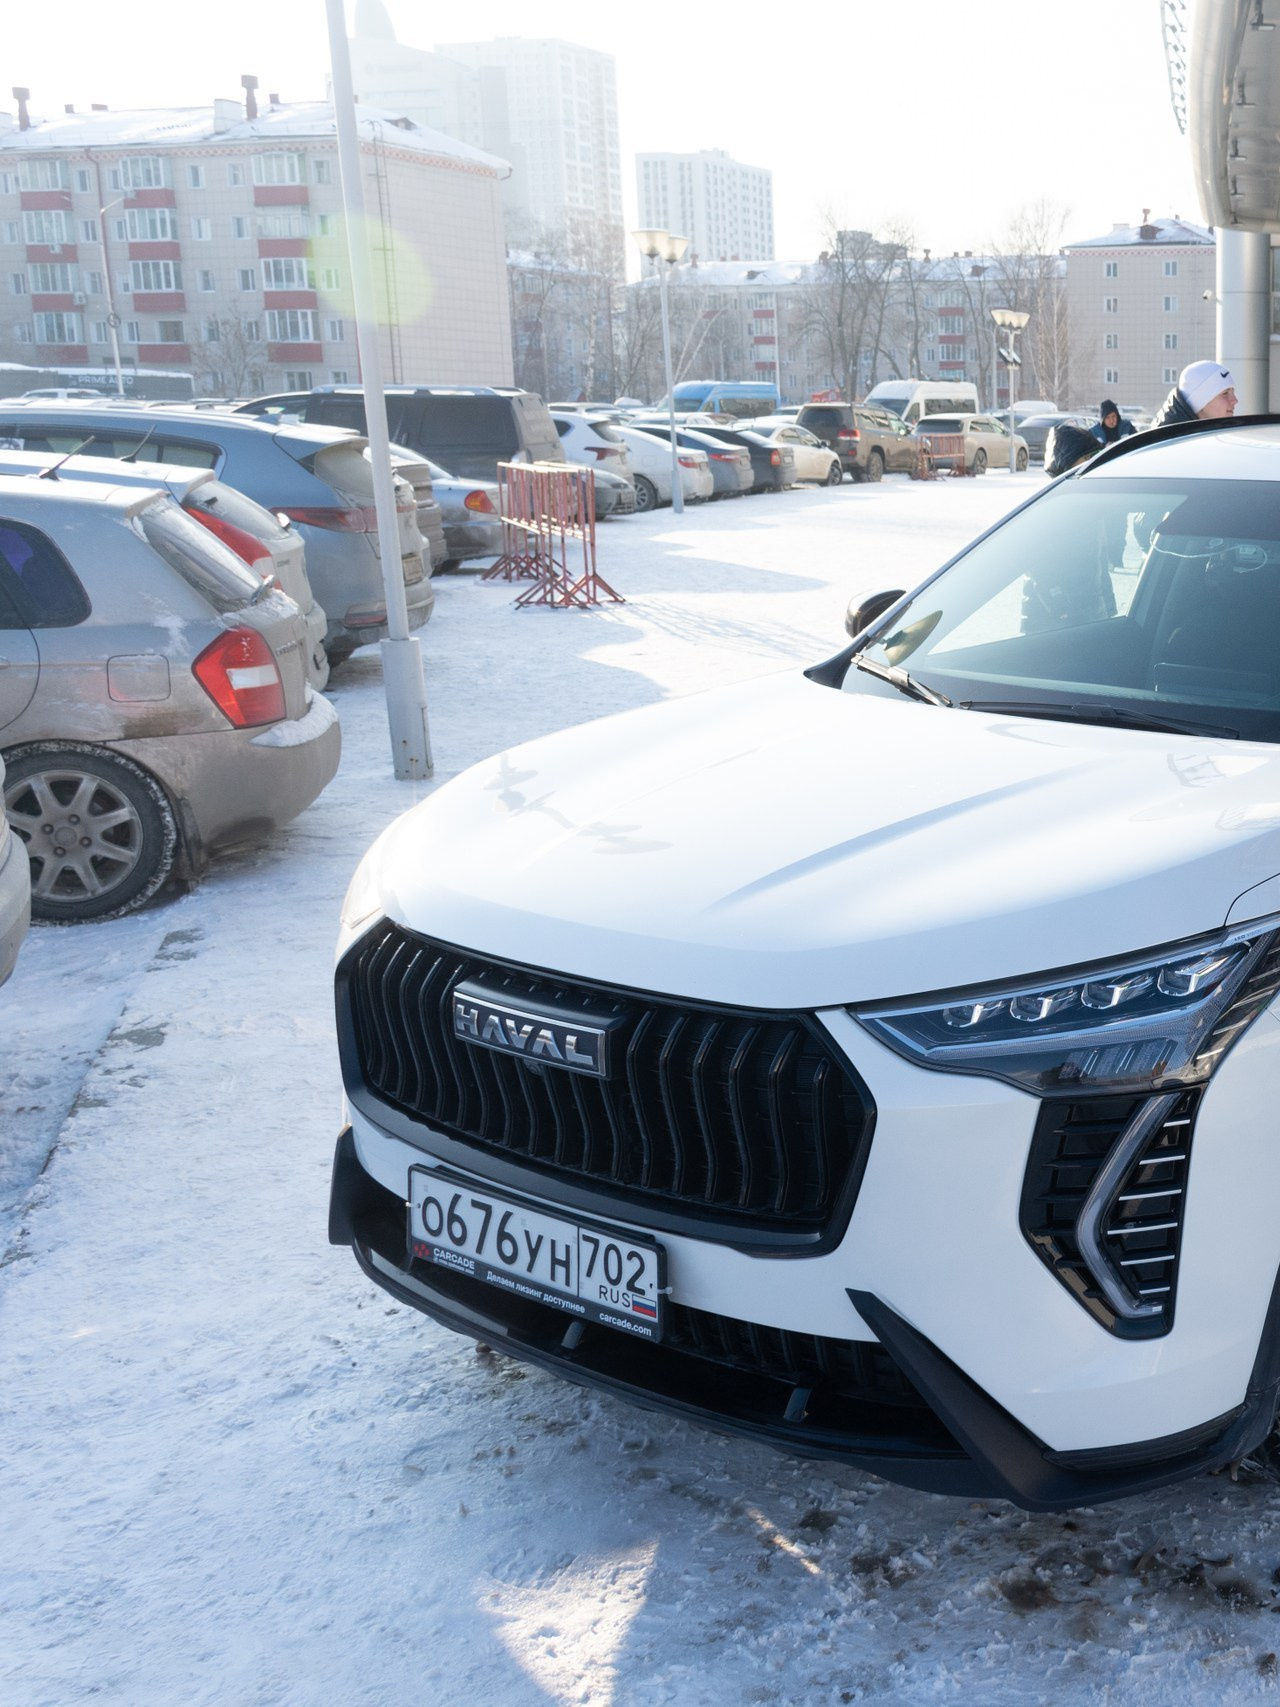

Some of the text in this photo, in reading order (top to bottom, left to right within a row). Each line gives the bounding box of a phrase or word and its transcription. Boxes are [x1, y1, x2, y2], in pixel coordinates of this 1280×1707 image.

[78, 375, 134, 385] PRIME ATO
[456, 1003, 594, 1066] HAVAL
[433, 1248, 475, 1270] CARCADE
[581, 1233, 646, 1296] 702
[486, 1270, 586, 1314] Делаем лизинг доступнее
[599, 1284, 631, 1308] RUS
[599, 1311, 652, 1337] carcade.com
